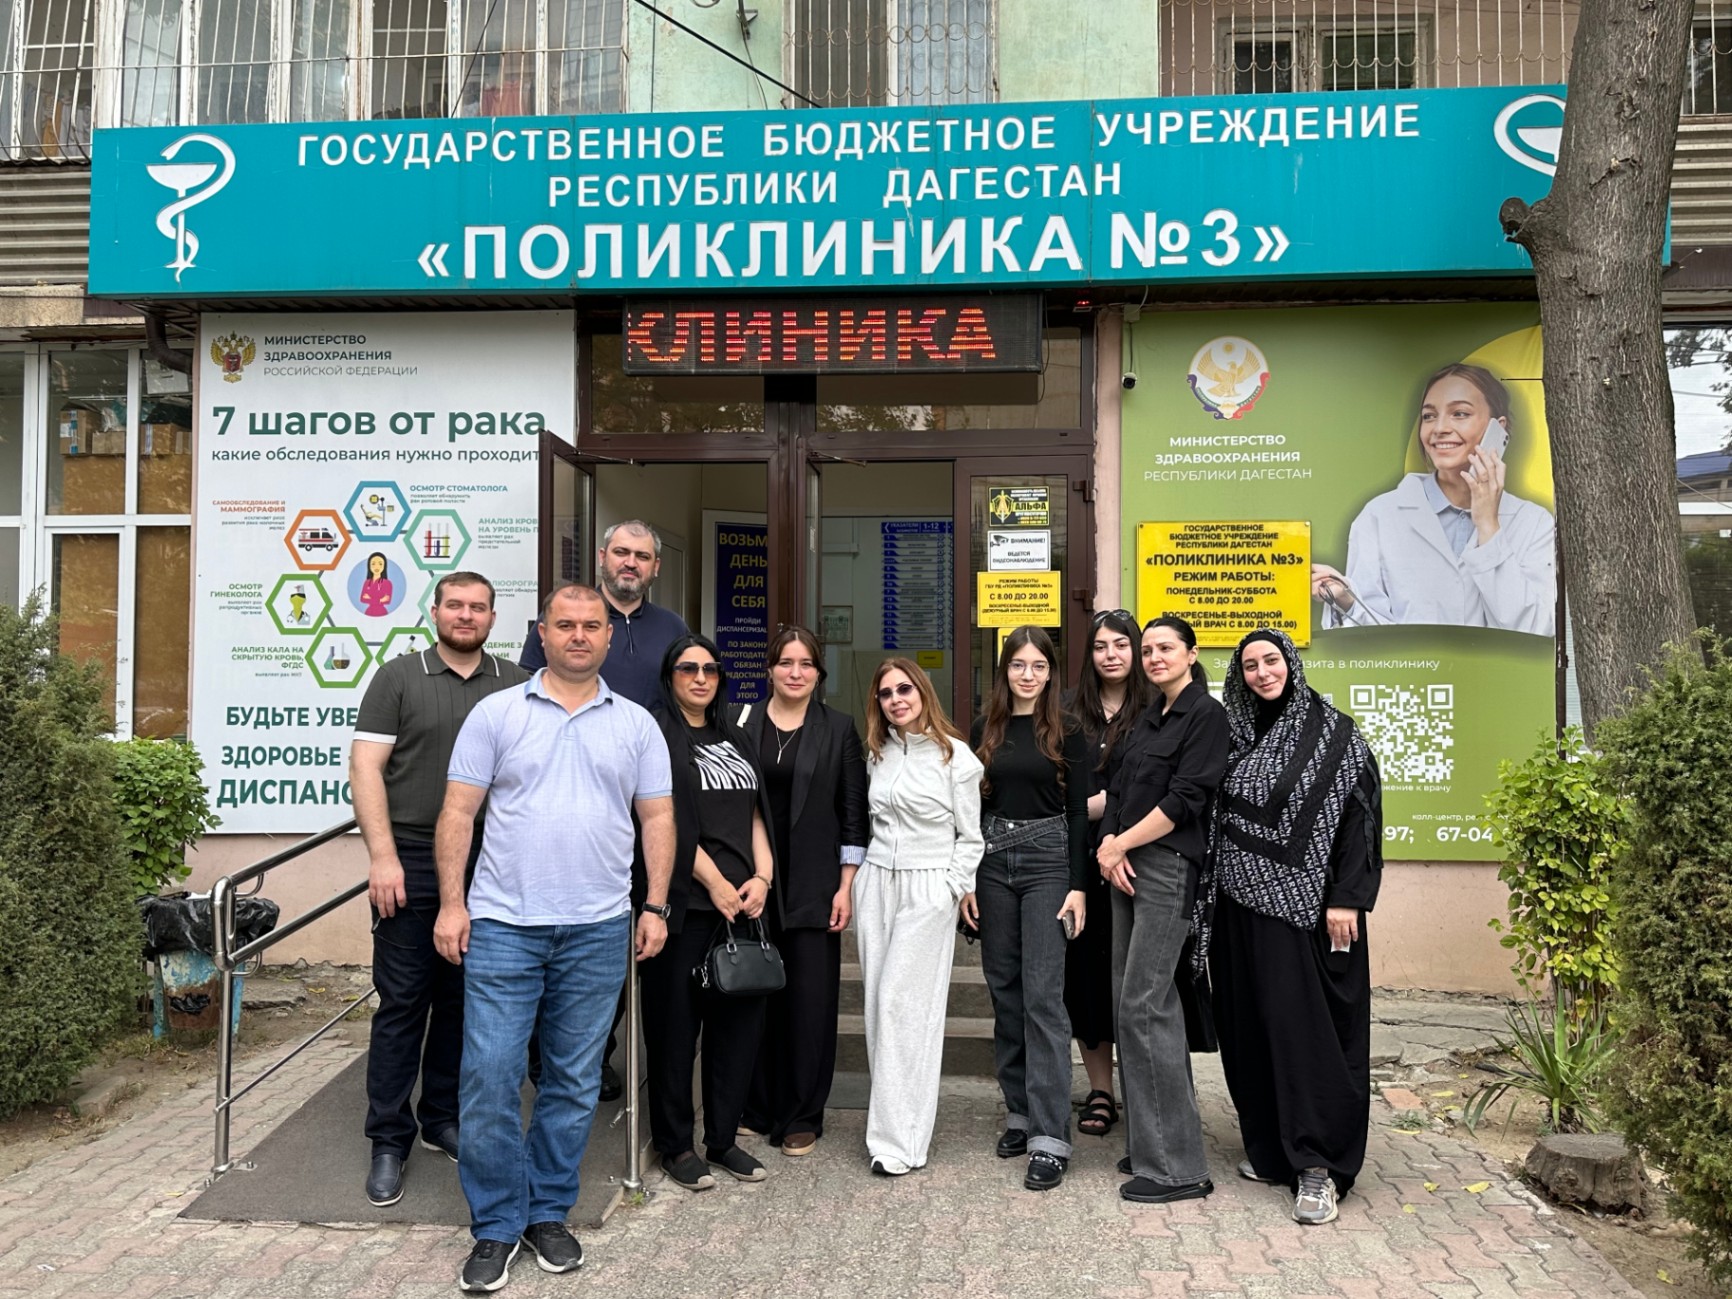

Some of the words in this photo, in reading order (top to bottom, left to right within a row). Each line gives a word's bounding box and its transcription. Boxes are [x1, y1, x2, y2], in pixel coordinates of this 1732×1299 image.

[298, 125, 724, 170] ГОСУДАРСТВЕННОЕ
[764, 116, 1055, 160] БЮДЖЕТНОЕ
[1097, 104, 1420, 148] УЧРЕЖДЕНИЕ
[549, 171, 837, 208] РЕСПУБЛИКИ
[883, 162, 1121, 208] ДАГЕСТАН
[417, 215, 1083, 279] «ПОЛИКЛИНИКА
[264, 335, 366, 346] МИНИСТЕРСТВО
[264, 351, 392, 362] ЗДРАВООХРАНЕНИЯ
[264, 365, 343, 376] РОССИЙСКОЙ
[345, 365, 418, 377] ФЕДЕРАЦИИ
[212, 406, 236, 436] 7
[249, 411, 376, 436] шагов
[389, 411, 435, 436] от
[449, 410, 545, 442] рака
[1170, 435, 1286, 447] МИНИСТЕРСТВО
[212, 449, 261, 461] какие
[266, 447, 390, 463] обследования
[396, 449, 452, 463] нужно
[458, 449, 540, 464] проходит
[1155, 451, 1300, 465] ЗДРАВООХРАНЕНИЯ
[1144, 470, 1236, 481] РЕСПУБЛИКИ
[1240, 469, 1312, 481] ДАГЕСТАН
[1184, 524, 1264, 532] ГОСУДАРСТВЕННОЕ
[719, 532, 768, 547] ВОЗЬМ
[1224, 532, 1278, 540] УЧРЕЖДЕНИЕ
[1230, 541, 1273, 549] ДАГЕСТАН
[730, 554, 768, 569] ДЕНЬ
[1146, 553, 1267, 566] «ПОЛИКЛИНИКА
[1270, 553, 1304, 565] №3»
[733, 574, 764, 590] ДЛЯ
[1174, 572, 1217, 581] РЕЖИМ
[1220, 572, 1275, 581] РАБОТЫ:
[1014, 593, 1027, 601] ДО
[1166, 587, 1277, 596] ПОНЕДЕЛЬНИК-СУББОТА
[731, 595, 766, 608] СЕБЯ
[1216, 597, 1229, 605] ДО
[1162, 610, 1282, 619] ВОСКРЕСЕНЬЕ-ВЫХОДНОЙ
[1204, 620, 1227, 628] ВРАЧ
[1229, 620, 1235, 628] С
[1238, 620, 1254, 628] 8.00
[1256, 620, 1270, 628] ДО
[275, 654, 304, 662] КРОВЬ,
[1338, 660, 1346, 668] в
[1350, 659, 1440, 671] поликлинику
[226, 706, 310, 730] БУДЬТЕ
[316, 707, 358, 727] УВЕ
[221, 745, 342, 769] ЗДОРОВЬЕ
[1424, 785, 1451, 793] врачу
[1383, 826, 1414, 844] 97;
[1436, 826, 1494, 842] 67-04
